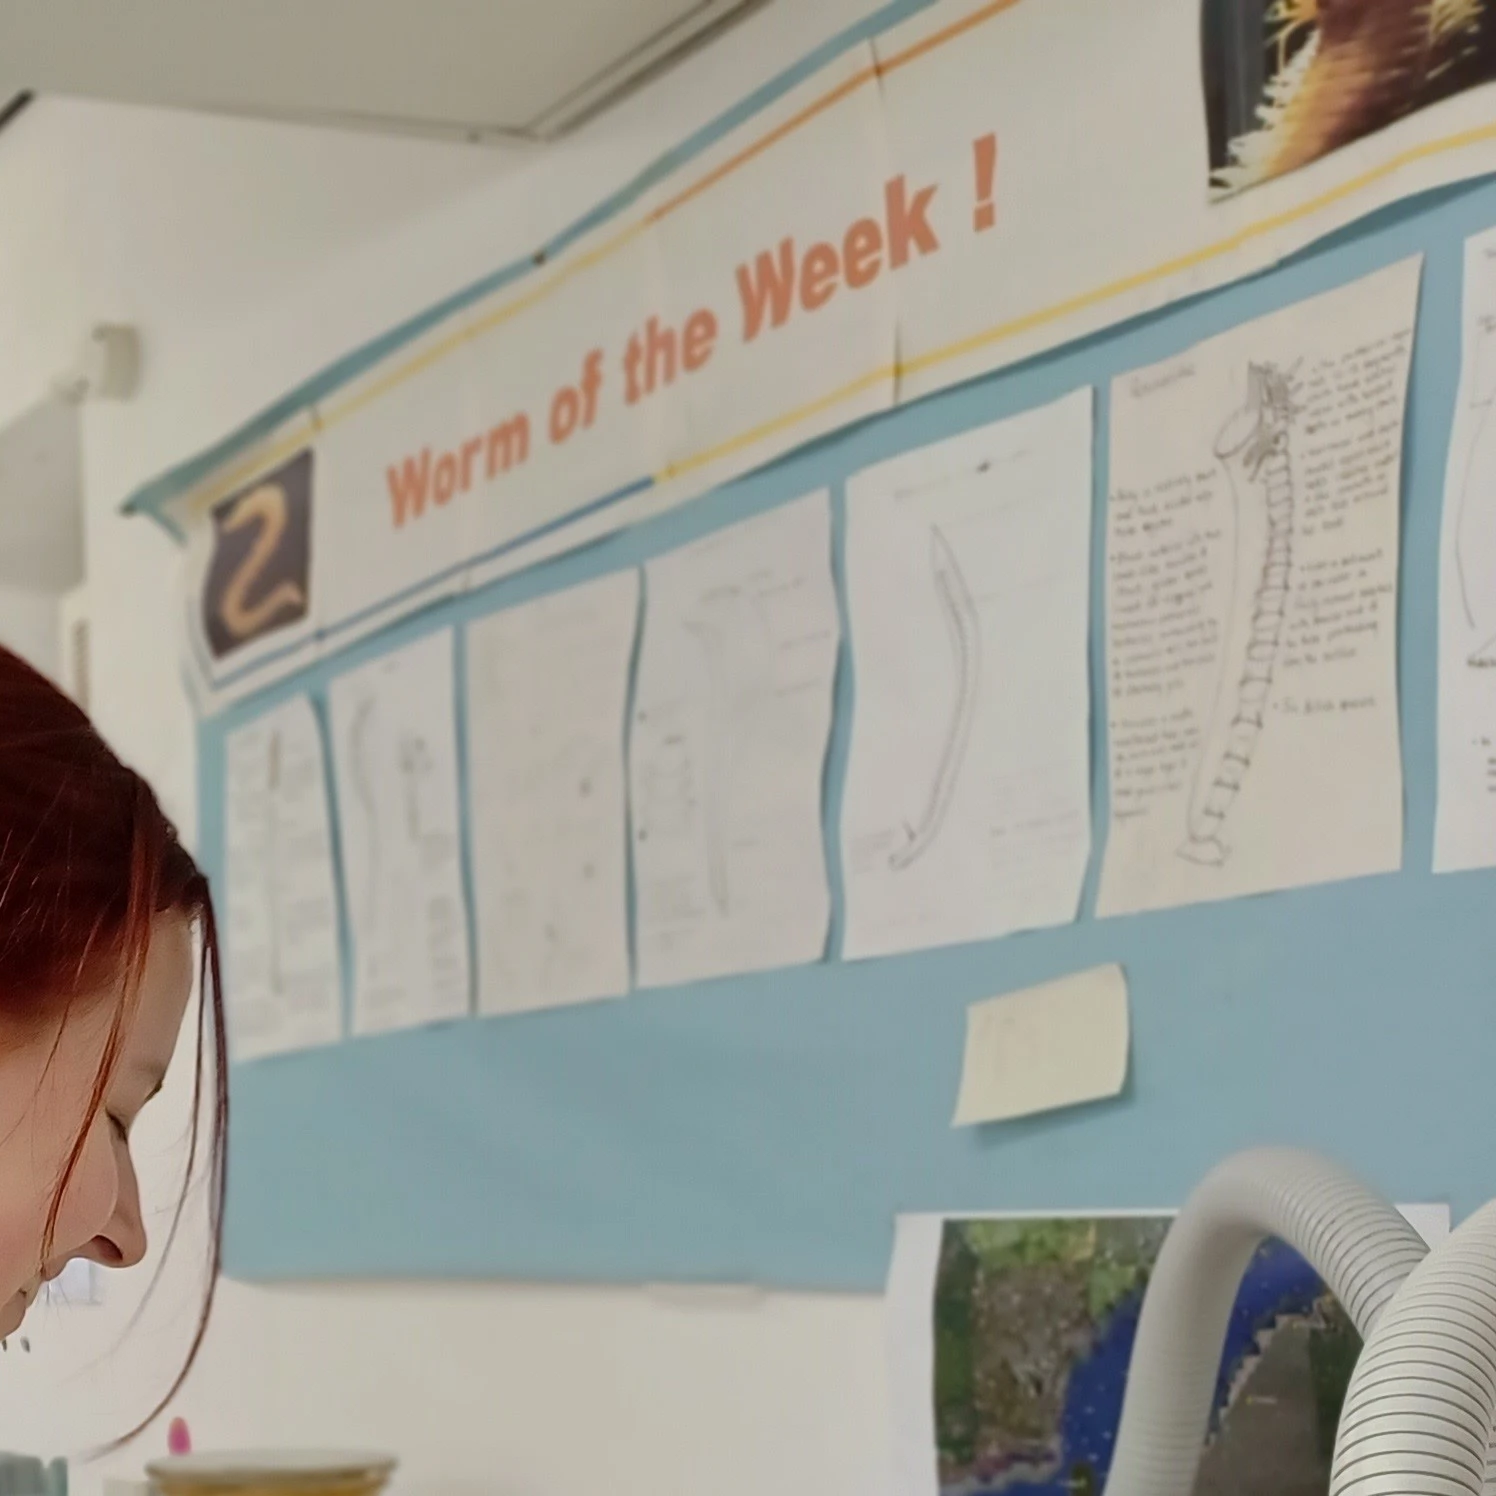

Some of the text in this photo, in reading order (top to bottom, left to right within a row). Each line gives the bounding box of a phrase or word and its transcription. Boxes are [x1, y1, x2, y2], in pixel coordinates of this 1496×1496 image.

[386, 132, 997, 529] Worm of the Week !
